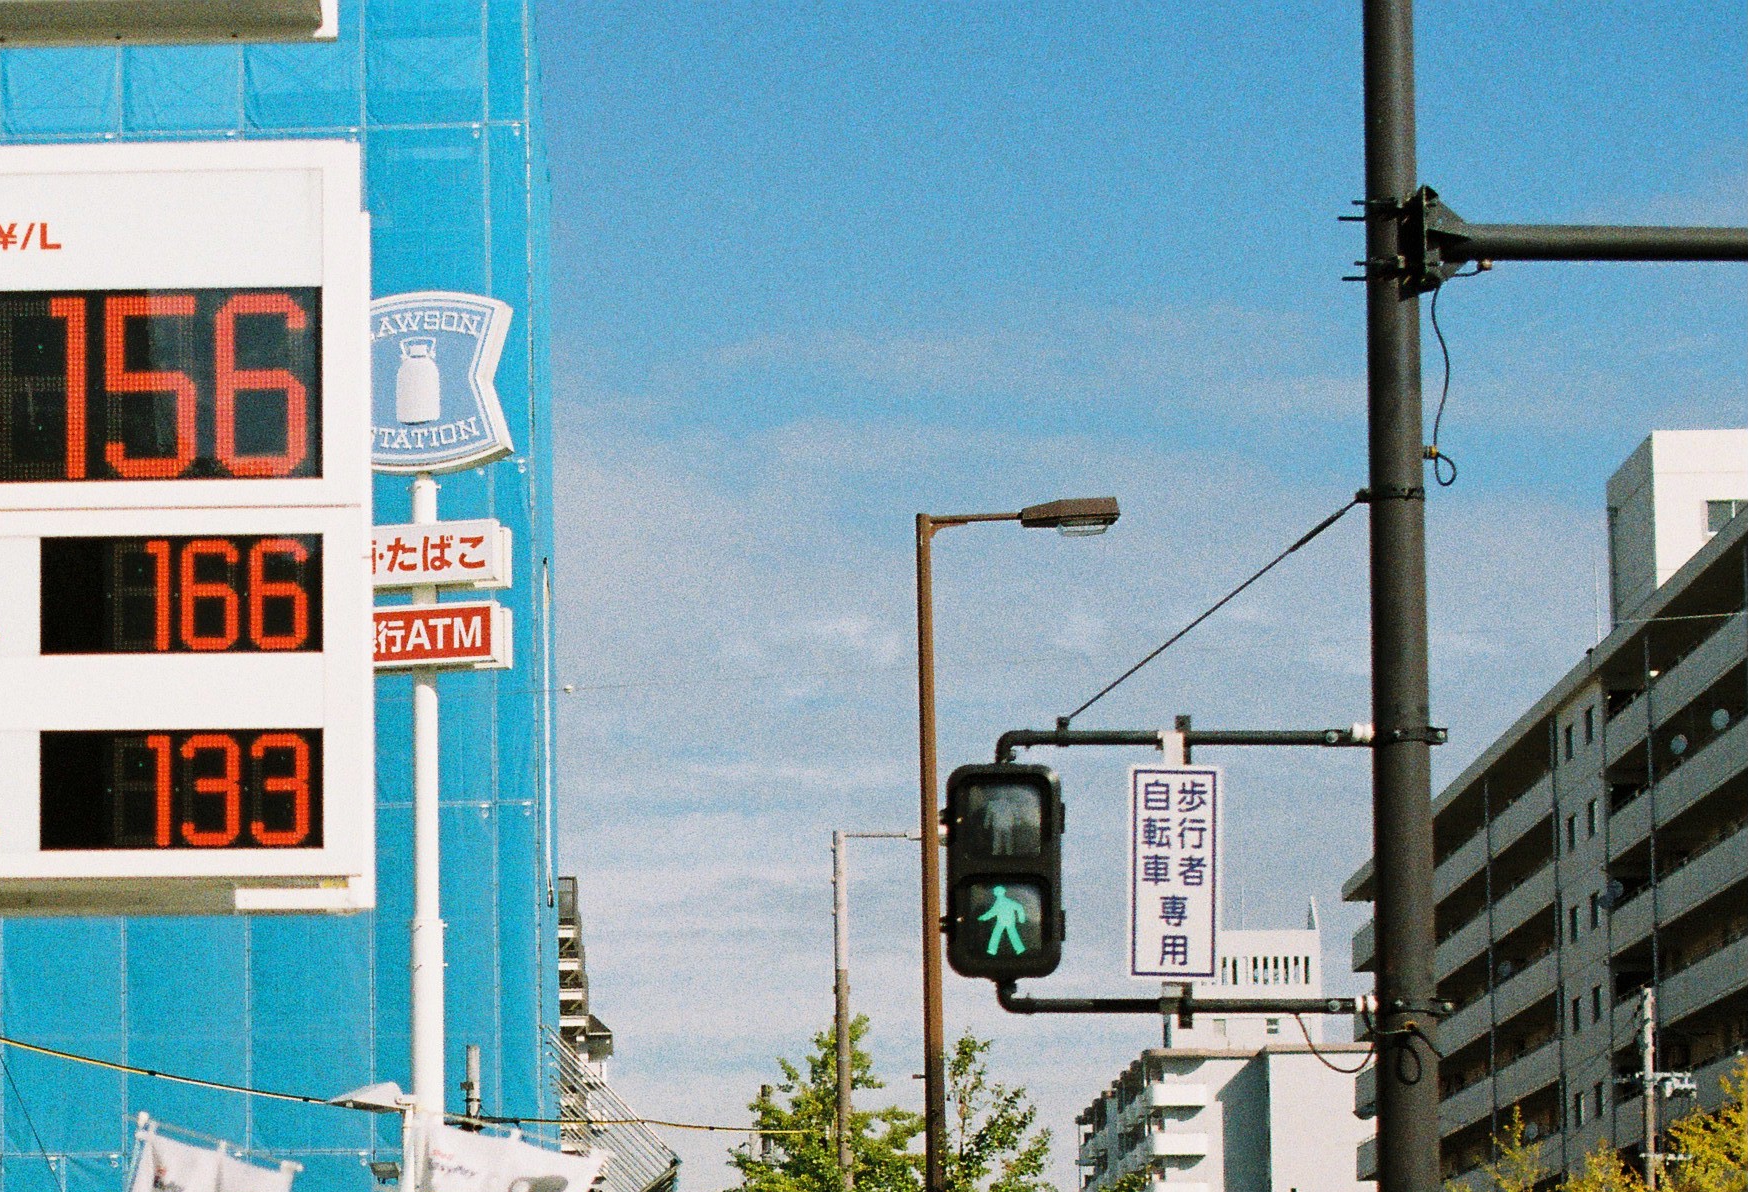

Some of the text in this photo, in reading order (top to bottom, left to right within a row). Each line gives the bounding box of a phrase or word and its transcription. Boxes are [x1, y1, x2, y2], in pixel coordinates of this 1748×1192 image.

[371, 310, 482, 342] AWSON
[50, 293, 309, 481] 156
[147, 539, 308, 651] 166
[373, 615, 483, 654] 行ATM
[147, 734, 310, 847] 133
[1141, 780, 1172, 886] 自転車
[1177, 780, 1208, 888] 歩行者
[1158, 895, 1189, 967] 専用
